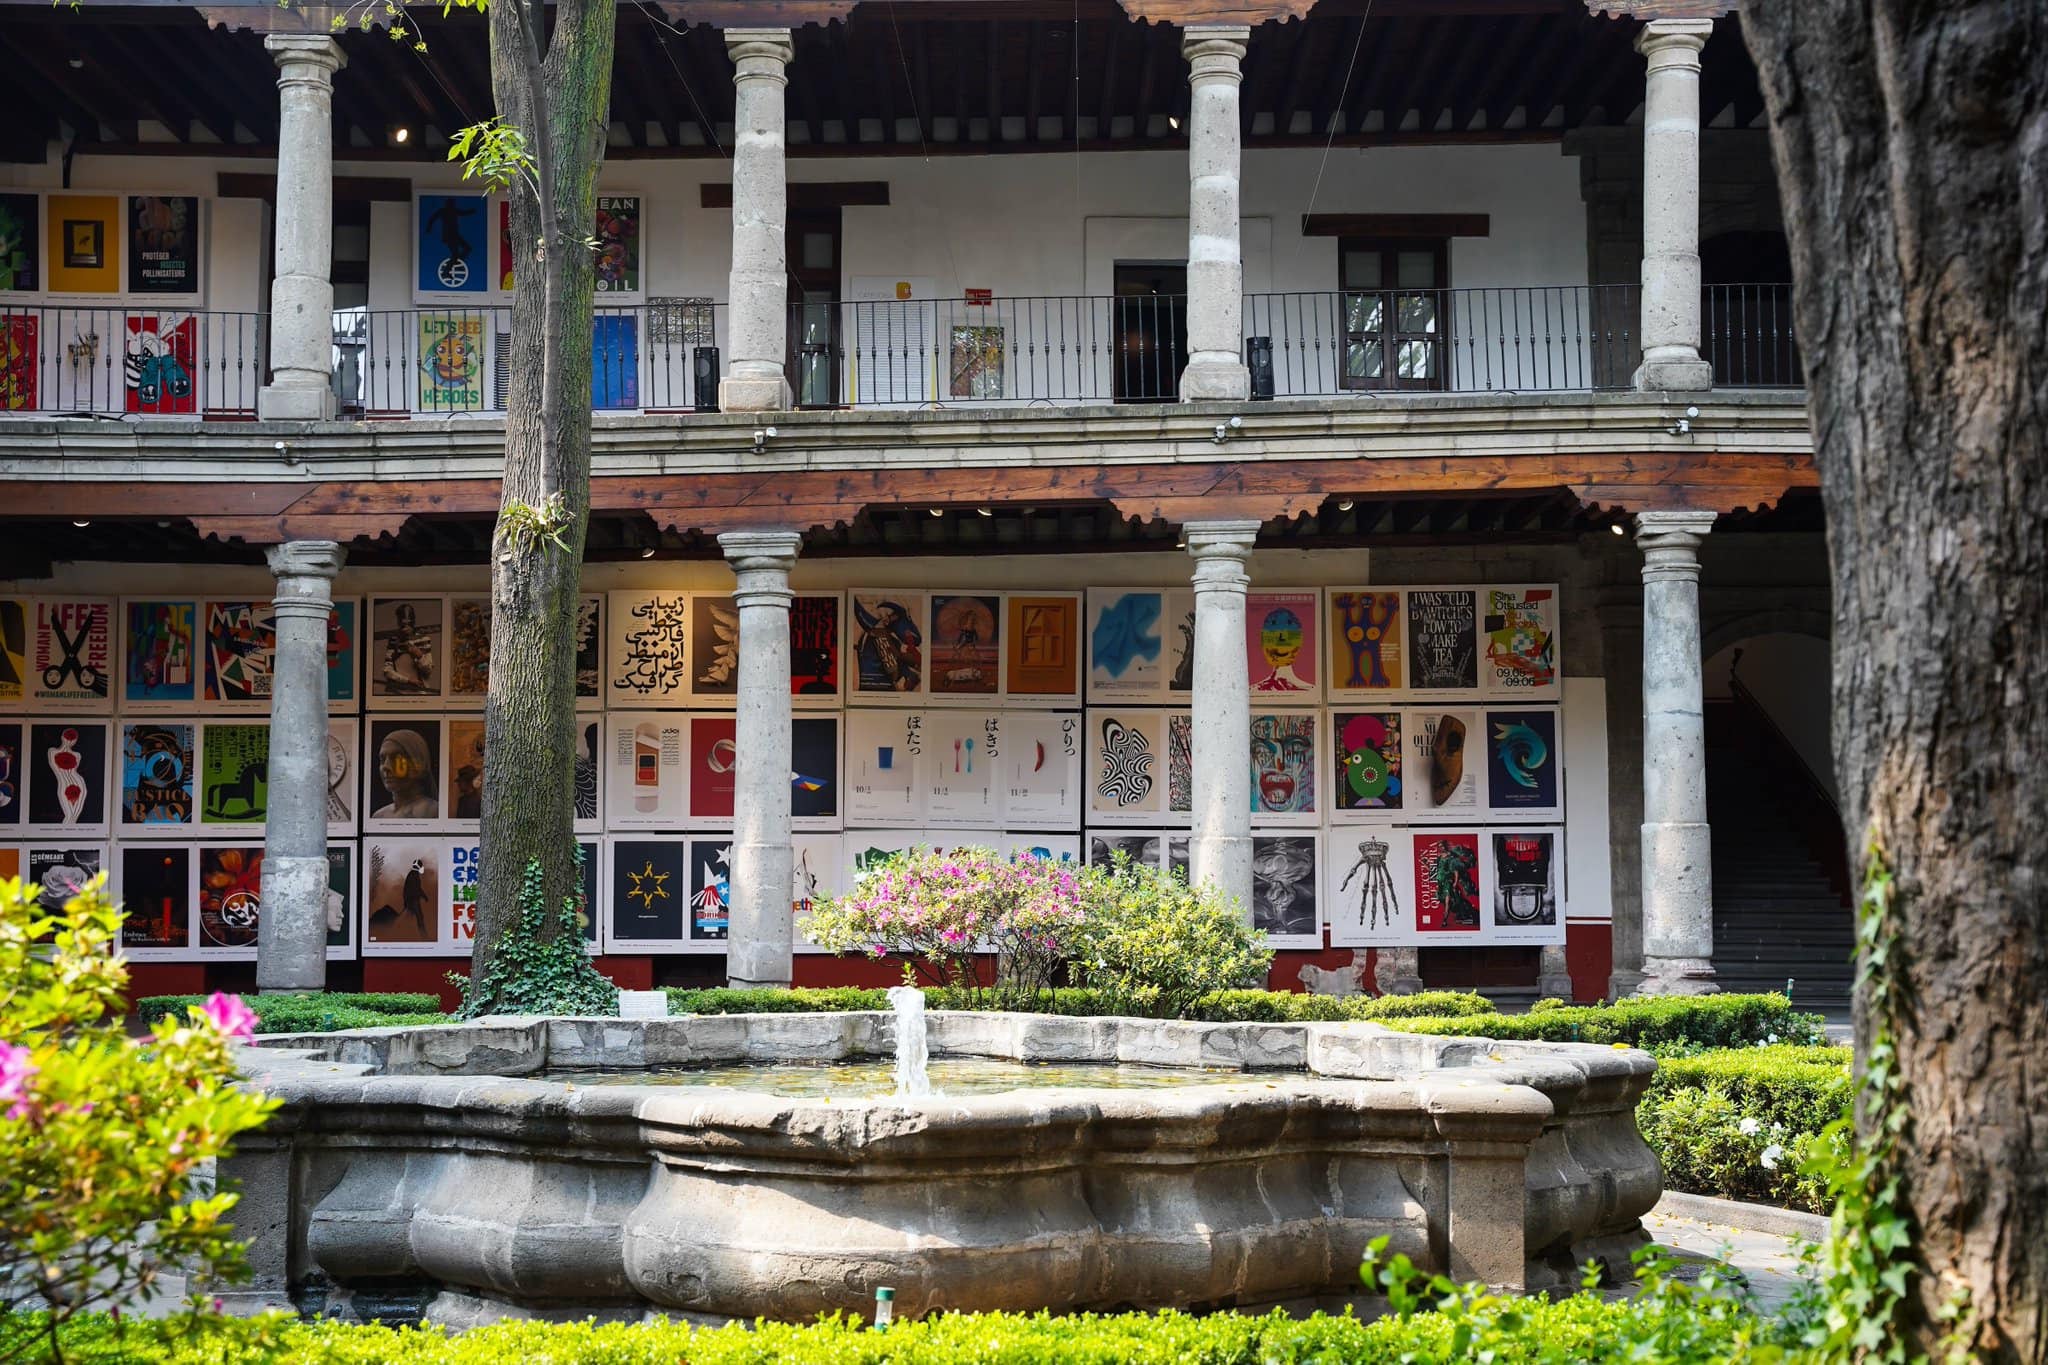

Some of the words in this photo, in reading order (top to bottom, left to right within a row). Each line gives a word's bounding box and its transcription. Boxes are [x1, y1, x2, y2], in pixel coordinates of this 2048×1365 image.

[599, 199, 634, 210] EAN
[596, 279, 633, 291] OIL
[457, 321, 481, 334] BEE
[423, 389, 480, 404] HEROES
[631, 596, 684, 619] زیبایی
[1419, 592, 1442, 606] WAS
[38, 604, 88, 630] LIFE
[88, 604, 108, 669] FREEDOM
[625, 625, 684, 643] فارسی
[36, 632, 51, 672] WOMAN
[614, 670, 684, 694] گرافیک
